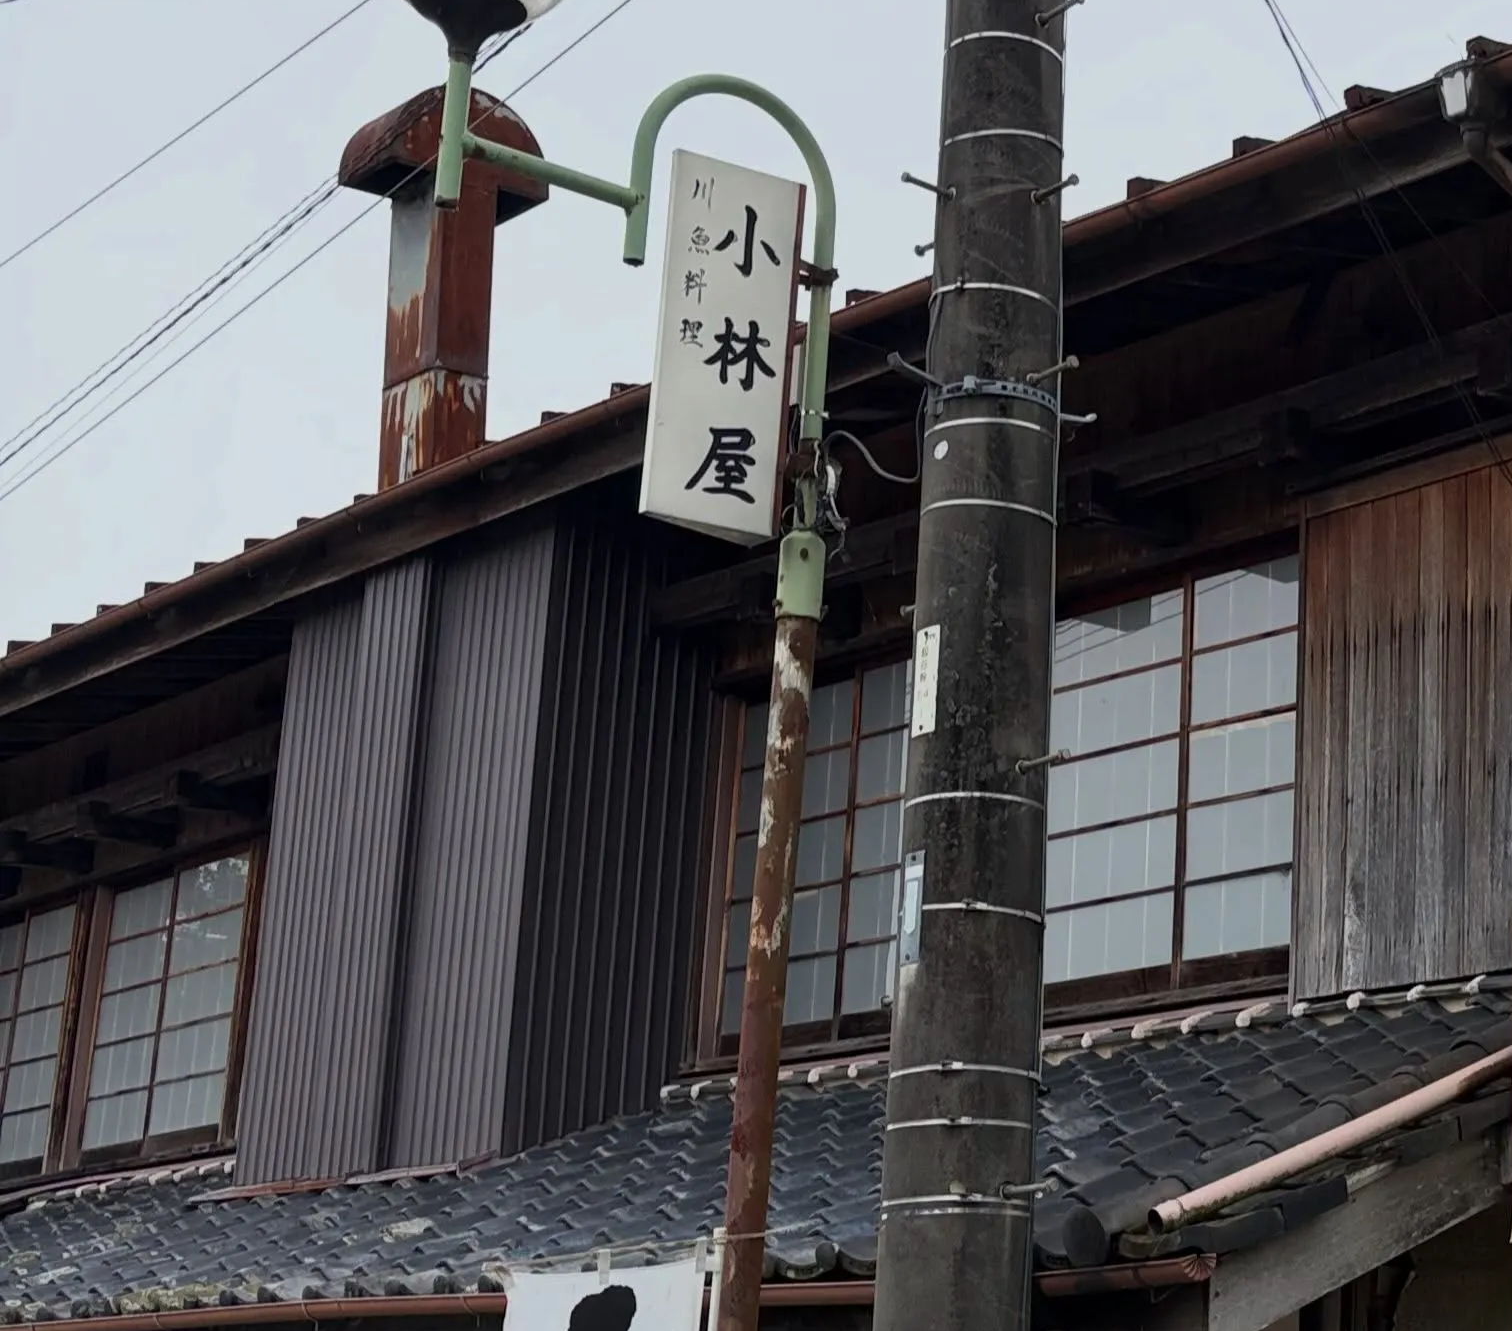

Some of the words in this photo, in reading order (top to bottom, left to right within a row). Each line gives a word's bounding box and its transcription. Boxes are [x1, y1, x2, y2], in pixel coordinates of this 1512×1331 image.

[679, 177, 715, 349] 川魚料理
[684, 204, 781, 504] 小林屋
